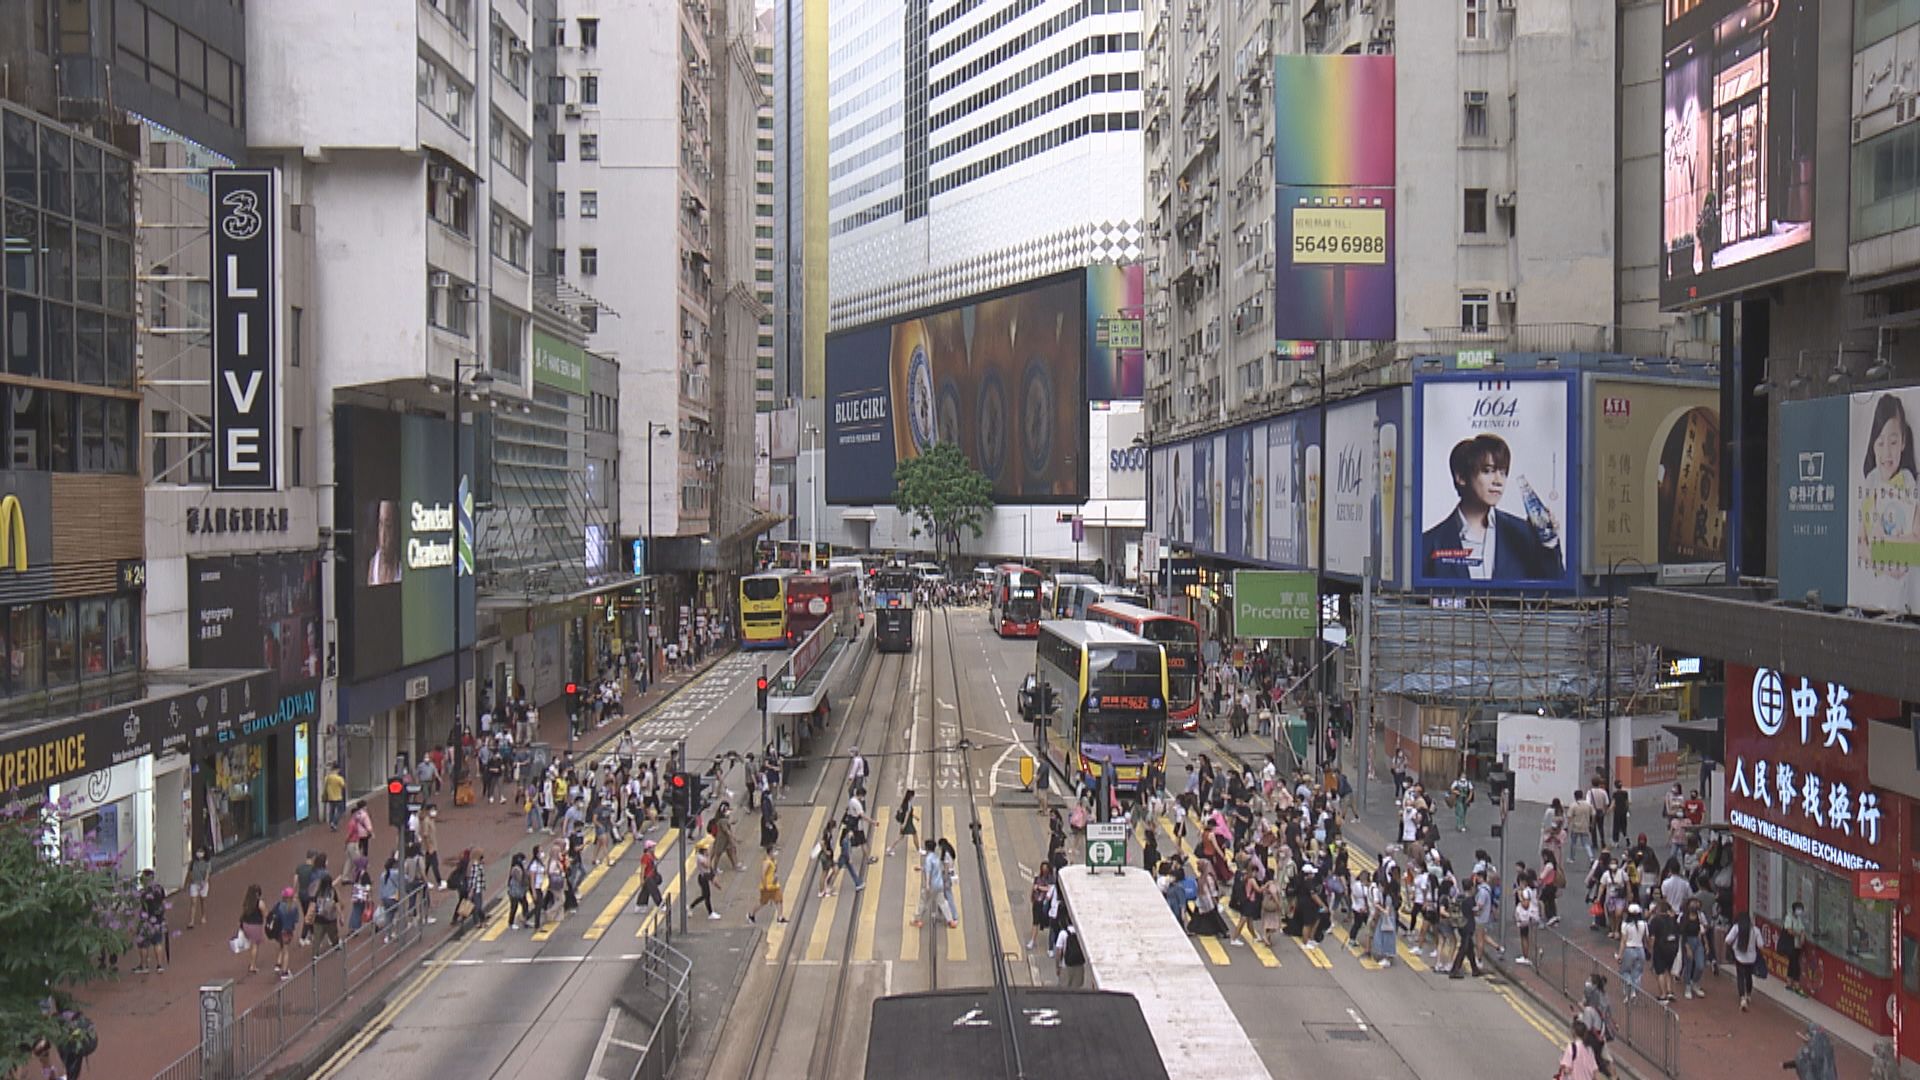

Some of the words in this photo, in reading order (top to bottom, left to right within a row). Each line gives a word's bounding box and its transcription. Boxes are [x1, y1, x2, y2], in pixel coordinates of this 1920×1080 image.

[1295, 236, 1338, 253] 5649
[1341, 236, 1384, 253] 6988
[224, 255, 262, 471] LIVE
[835, 400, 860, 424] BLUE
[860, 396, 886, 419] GIRL
[1473, 397, 1518, 417] 1664
[1110, 449, 1145, 473] SOGO
[1791, 676, 1853, 755] 中英
[1730, 755, 1881, 845] 人民幣找換行
[1730, 809, 1757, 832] CHUNG
[1757, 820, 1777, 842] YING
[1777, 827, 1811, 853] REMINBI
[1811, 839, 1863, 872] EXCHANGE
